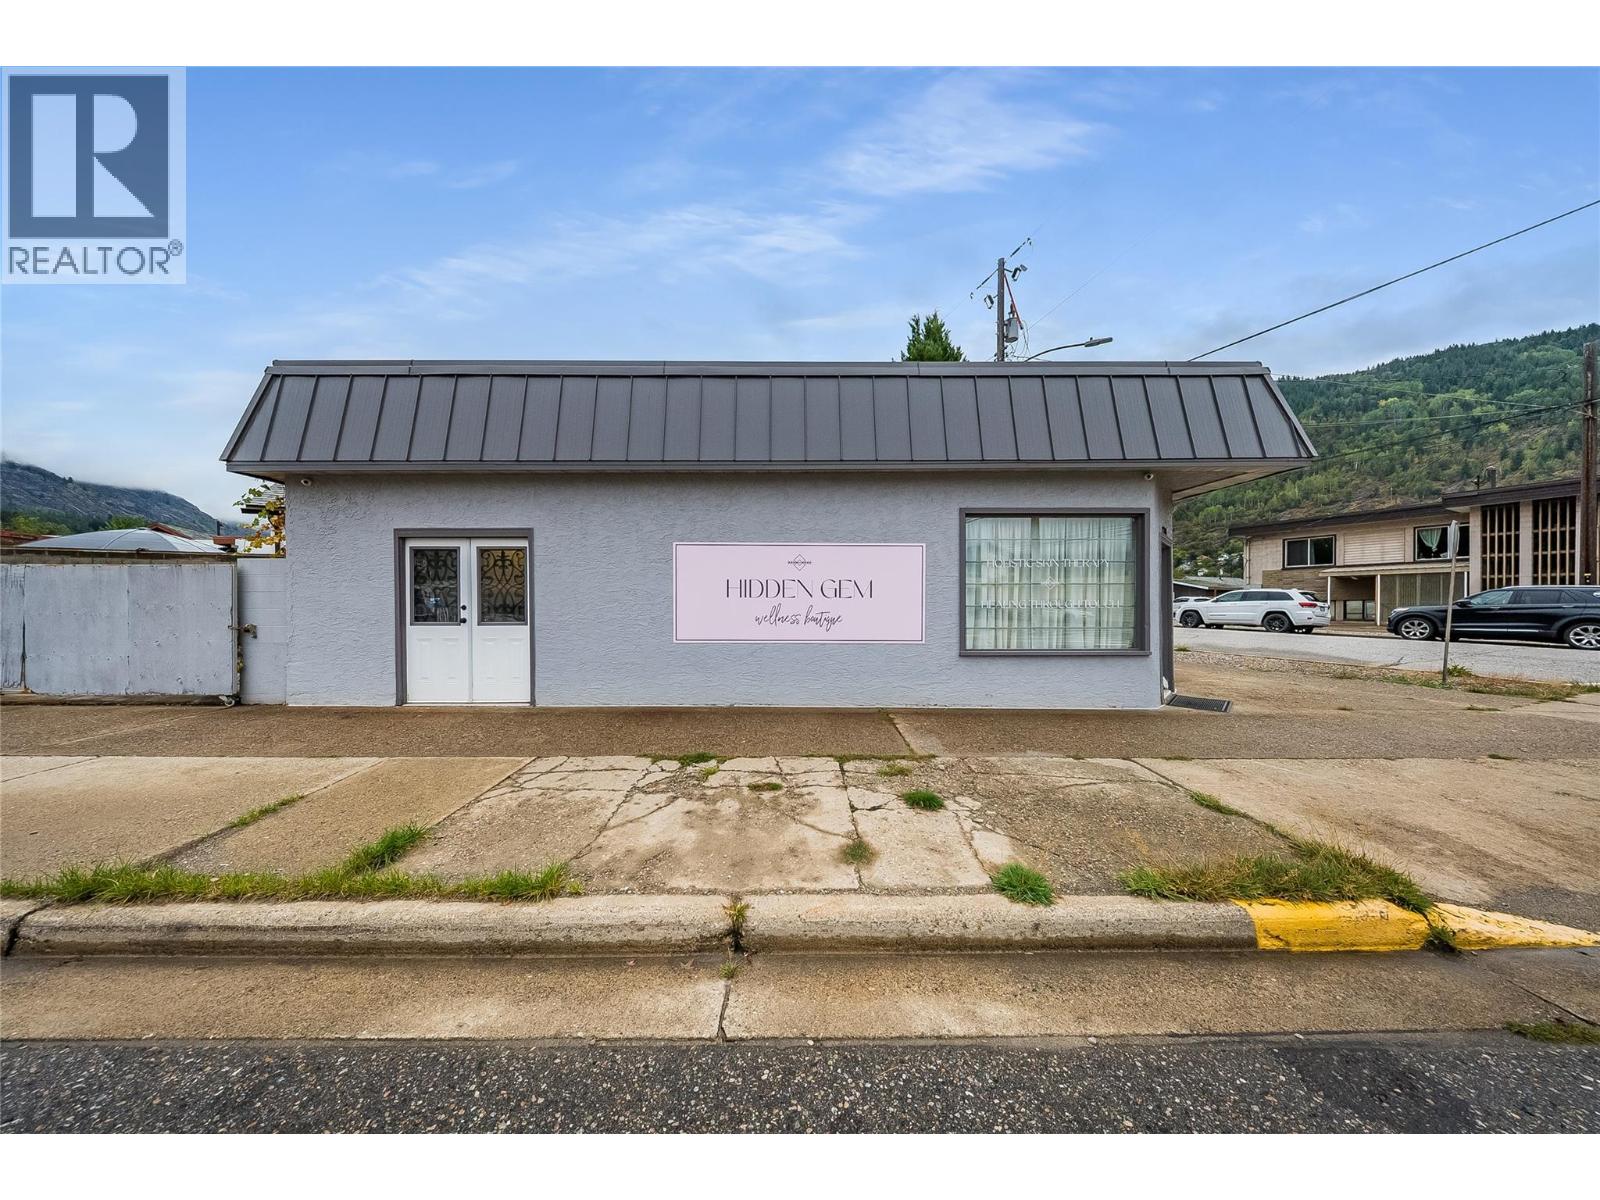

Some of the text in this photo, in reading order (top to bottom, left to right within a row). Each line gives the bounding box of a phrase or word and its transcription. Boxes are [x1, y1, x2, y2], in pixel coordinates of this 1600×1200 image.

[1036, 558, 1060, 568] SKIN
[1062, 558, 1110, 568] THERAPY
[726, 578, 873, 599] HIDDEN GEM
[980, 599, 1027, 609] HEALING
[1028, 599, 1081, 609] THROUGH
[754, 602, 843, 633] wellness boutique
